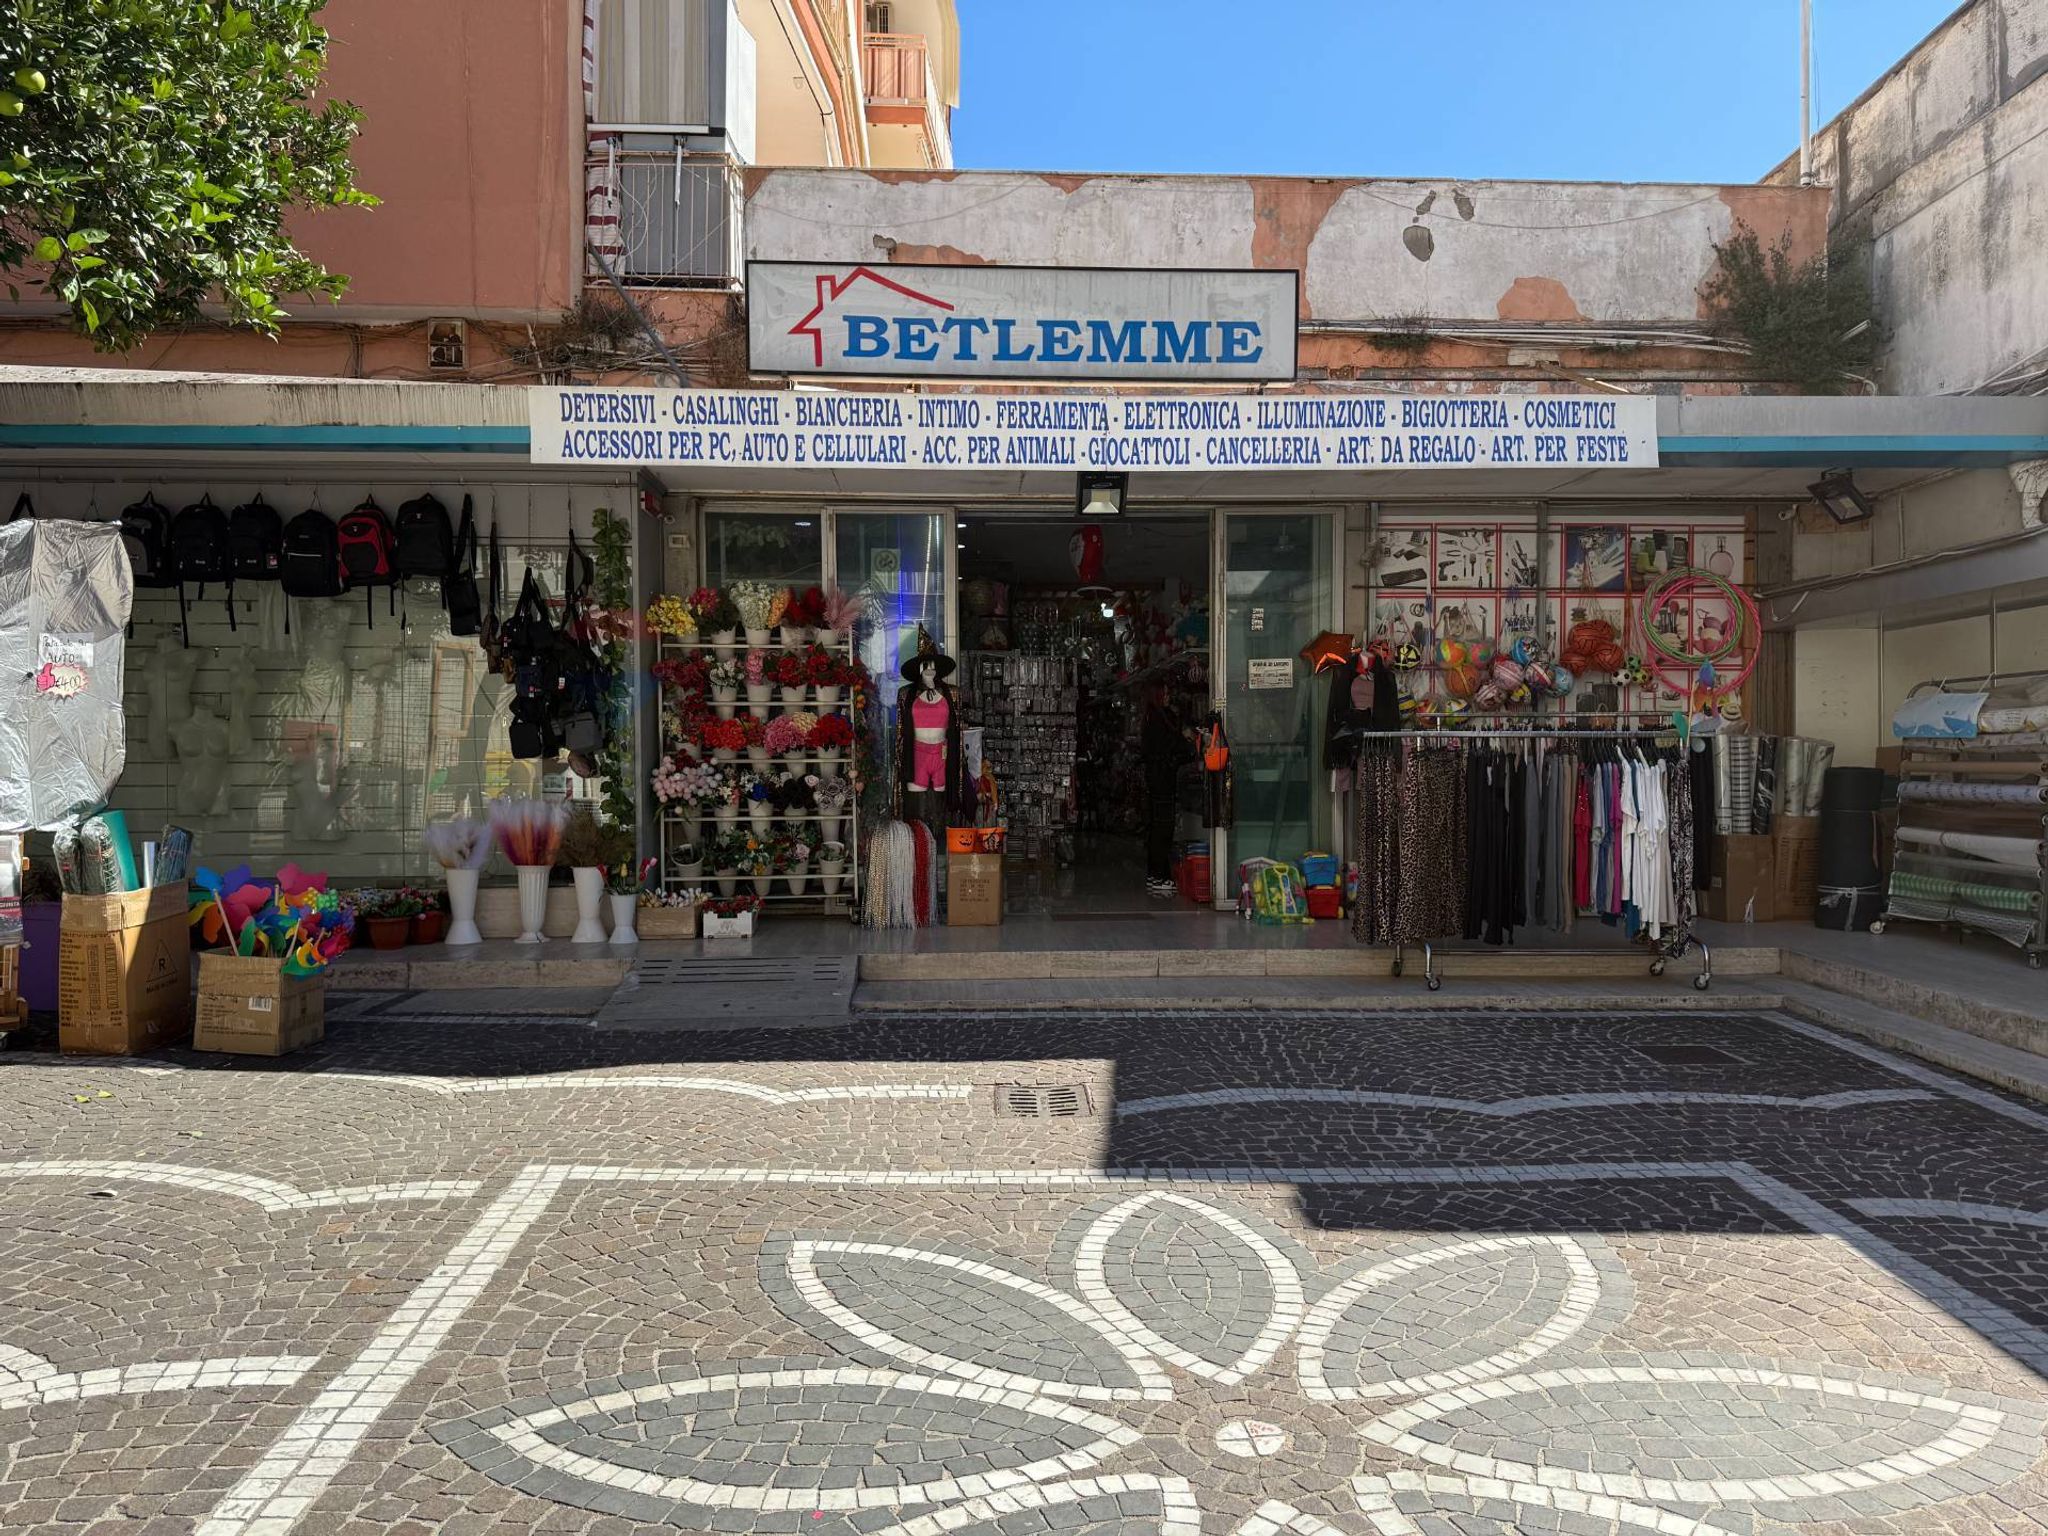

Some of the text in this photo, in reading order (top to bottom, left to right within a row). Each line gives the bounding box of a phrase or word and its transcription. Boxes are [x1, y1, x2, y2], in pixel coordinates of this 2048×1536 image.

[843, 314, 1263, 363] BETLEMME
[560, 393, 1616, 431] DETERSIVI CASALINGHI BIANCHERIA INTIMO FERRAMENTA ELETTRONICA ILLUMINAZIONE BIGIOTTERIA COSMETICI
[561, 430, 1628, 465] ACCESSORI PER PC, AUTO E CELLULARI ACC. PER ANIMALI GIOCATTOLI CANCELLERIA ART. DA REGALO ART. PER FESTE
